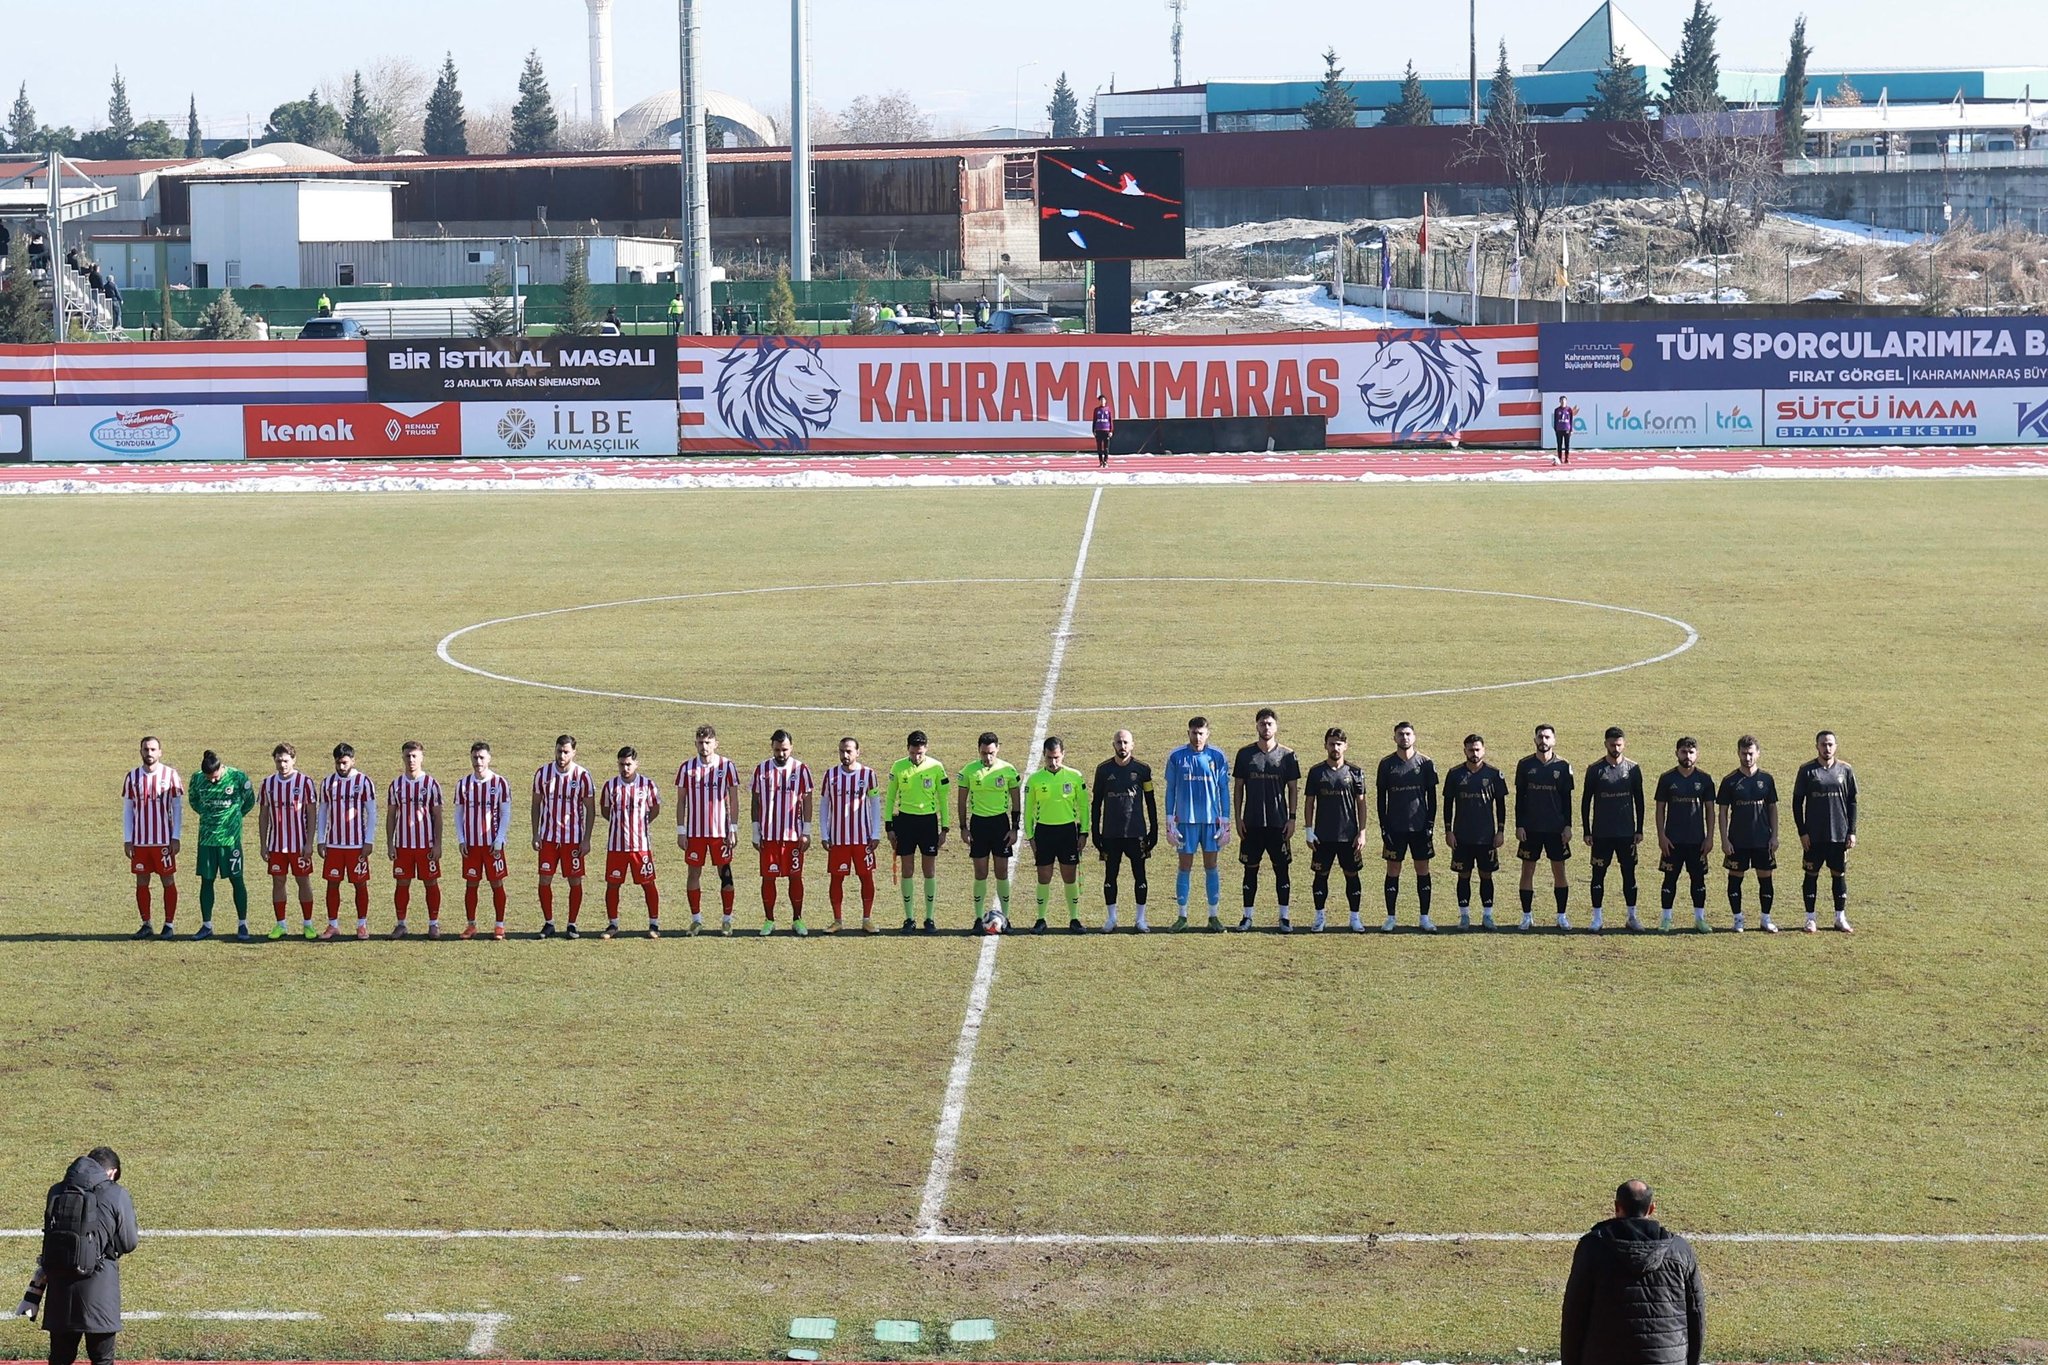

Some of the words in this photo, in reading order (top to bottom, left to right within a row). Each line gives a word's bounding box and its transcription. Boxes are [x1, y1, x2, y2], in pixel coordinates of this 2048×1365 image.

[1656, 327, 1724, 361] TÜM
[1732, 329, 2017, 360] SPORCULARIMIZA
[2025, 330, 2048, 356] B
[389, 348, 430, 369] BİR
[439, 346, 550, 368] İSTİKLAL
[560, 349, 655, 367] MASALI
[1564, 353, 1620, 362] Kahramanmaraş
[1789, 370, 1835, 382] FIRAT
[1839, 367, 1904, 382] GÖRGEL
[1912, 368, 2020, 381] KAHRAMANMARAŞ
[444, 380, 454, 388] 23
[457, 379, 503, 388] ARALIK'TA
[505, 378, 537, 387] ARSAN
[539, 376, 600, 387] SİNEMASI'NDA
[1776, 395, 1879, 423] SÜTÇÜ
[1888, 395, 1977, 419] İMAM
[553, 404, 634, 435] İLBE
[1606, 406, 1697, 430] triaform
[1716, 405, 1753, 429] tria
[98, 427, 170, 440] marasta
[261, 418, 354, 442] kemak
[1778, 426, 1864, 437] BRANDA
[1889, 426, 1974, 436] TEKSTİL
[547, 438, 640, 453] KUMAŞÇILIK
[161, 856, 173, 868] 11
[230, 857, 242, 871] 71
[429, 860, 437, 872] 8
[493, 859, 504, 872] 10
[572, 858, 580, 870] 9
[791, 857, 800, 869] 3
[864, 854, 874, 867] 13
[354, 862, 368, 875] 42
[640, 862, 653, 876] 49
